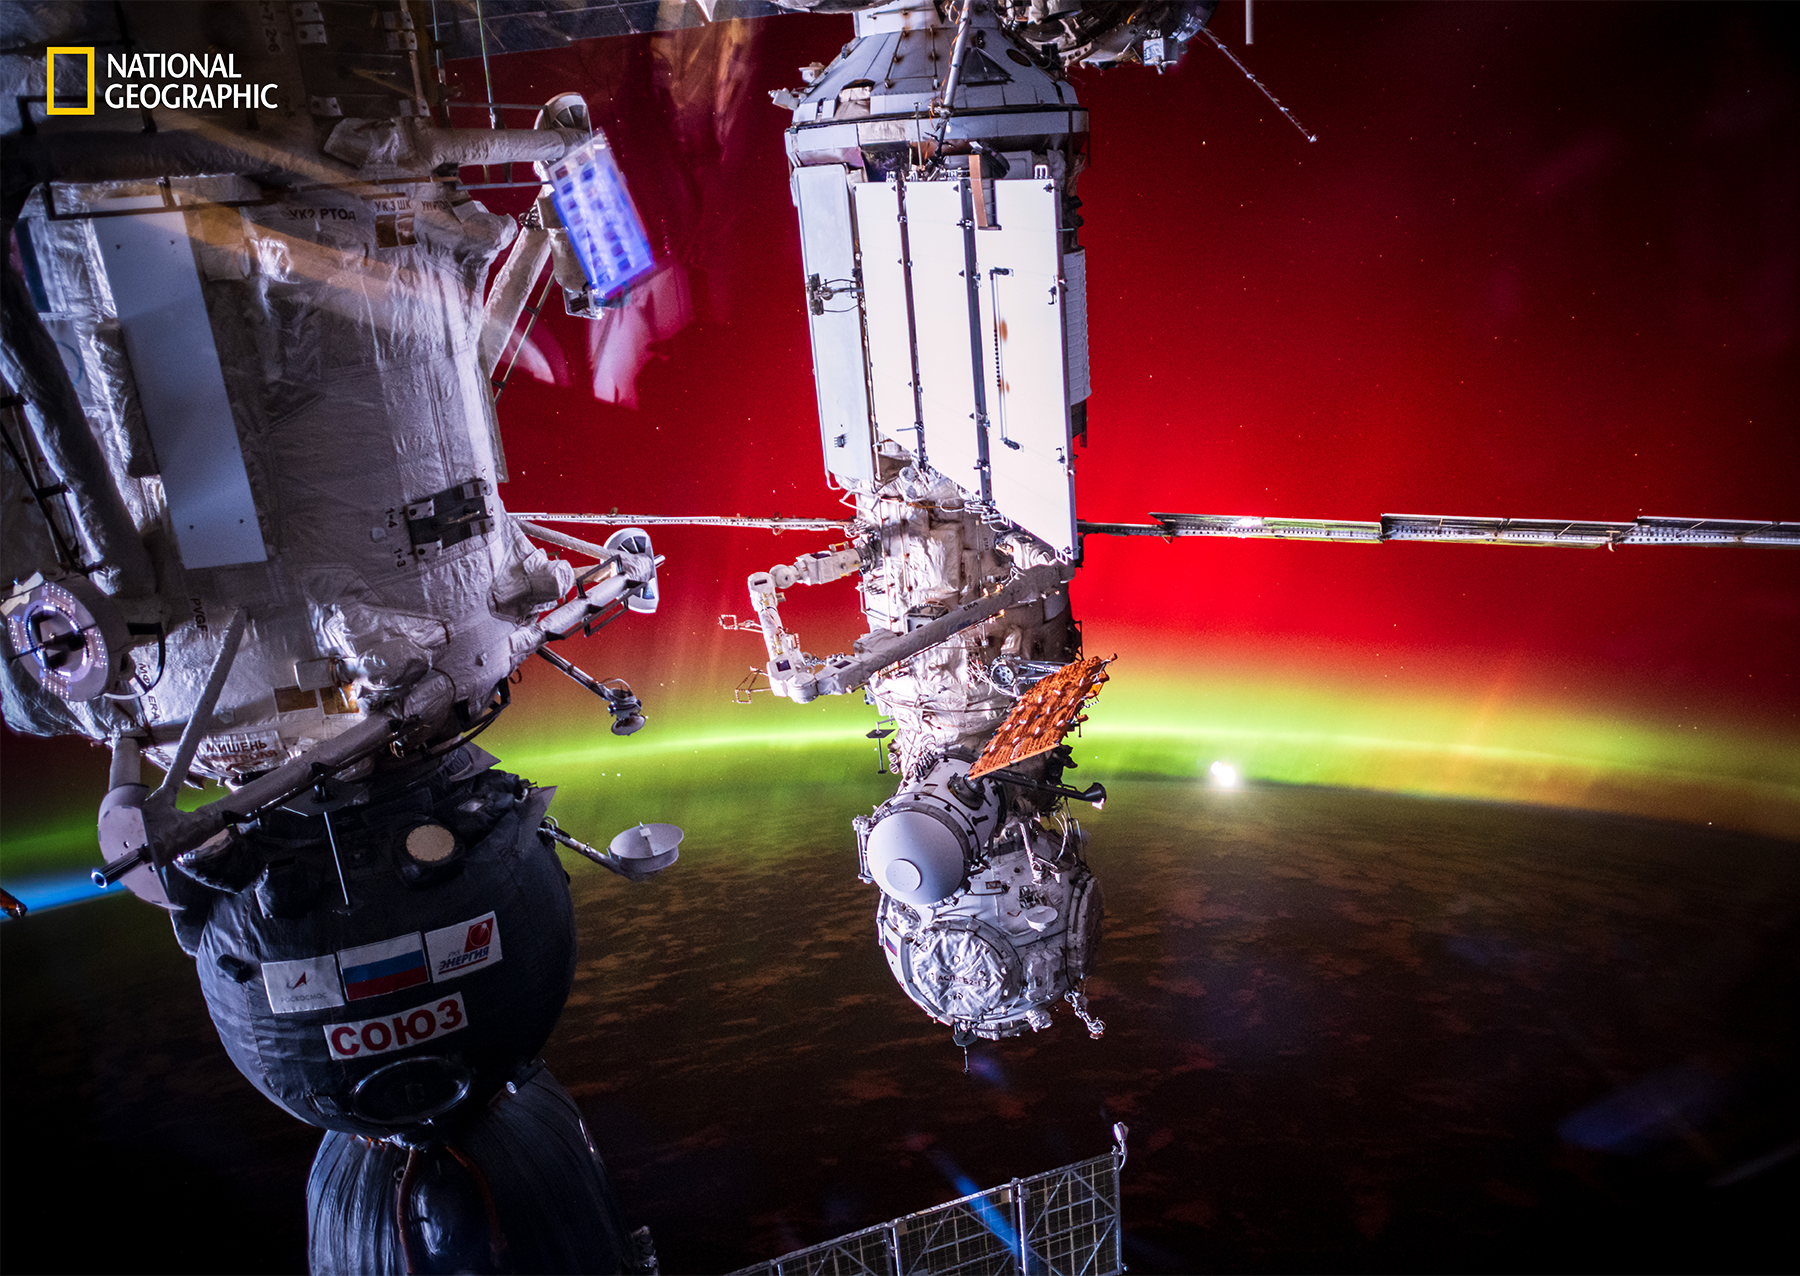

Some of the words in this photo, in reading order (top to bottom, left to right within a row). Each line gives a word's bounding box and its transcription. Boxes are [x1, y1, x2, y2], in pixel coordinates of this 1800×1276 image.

[385, 507, 397, 529] 1-4
[393, 547, 406, 568] 1-3
[190, 598, 208, 632] PVGF
[147, 695, 160, 720] ERA
[206, 740, 267, 753] МИШЕНЬ
[438, 946, 490, 971] ЭНЕРГИЯ
[280, 992, 327, 1003] РОСКОСМОС
[331, 999, 463, 1055] СОЮЗ
